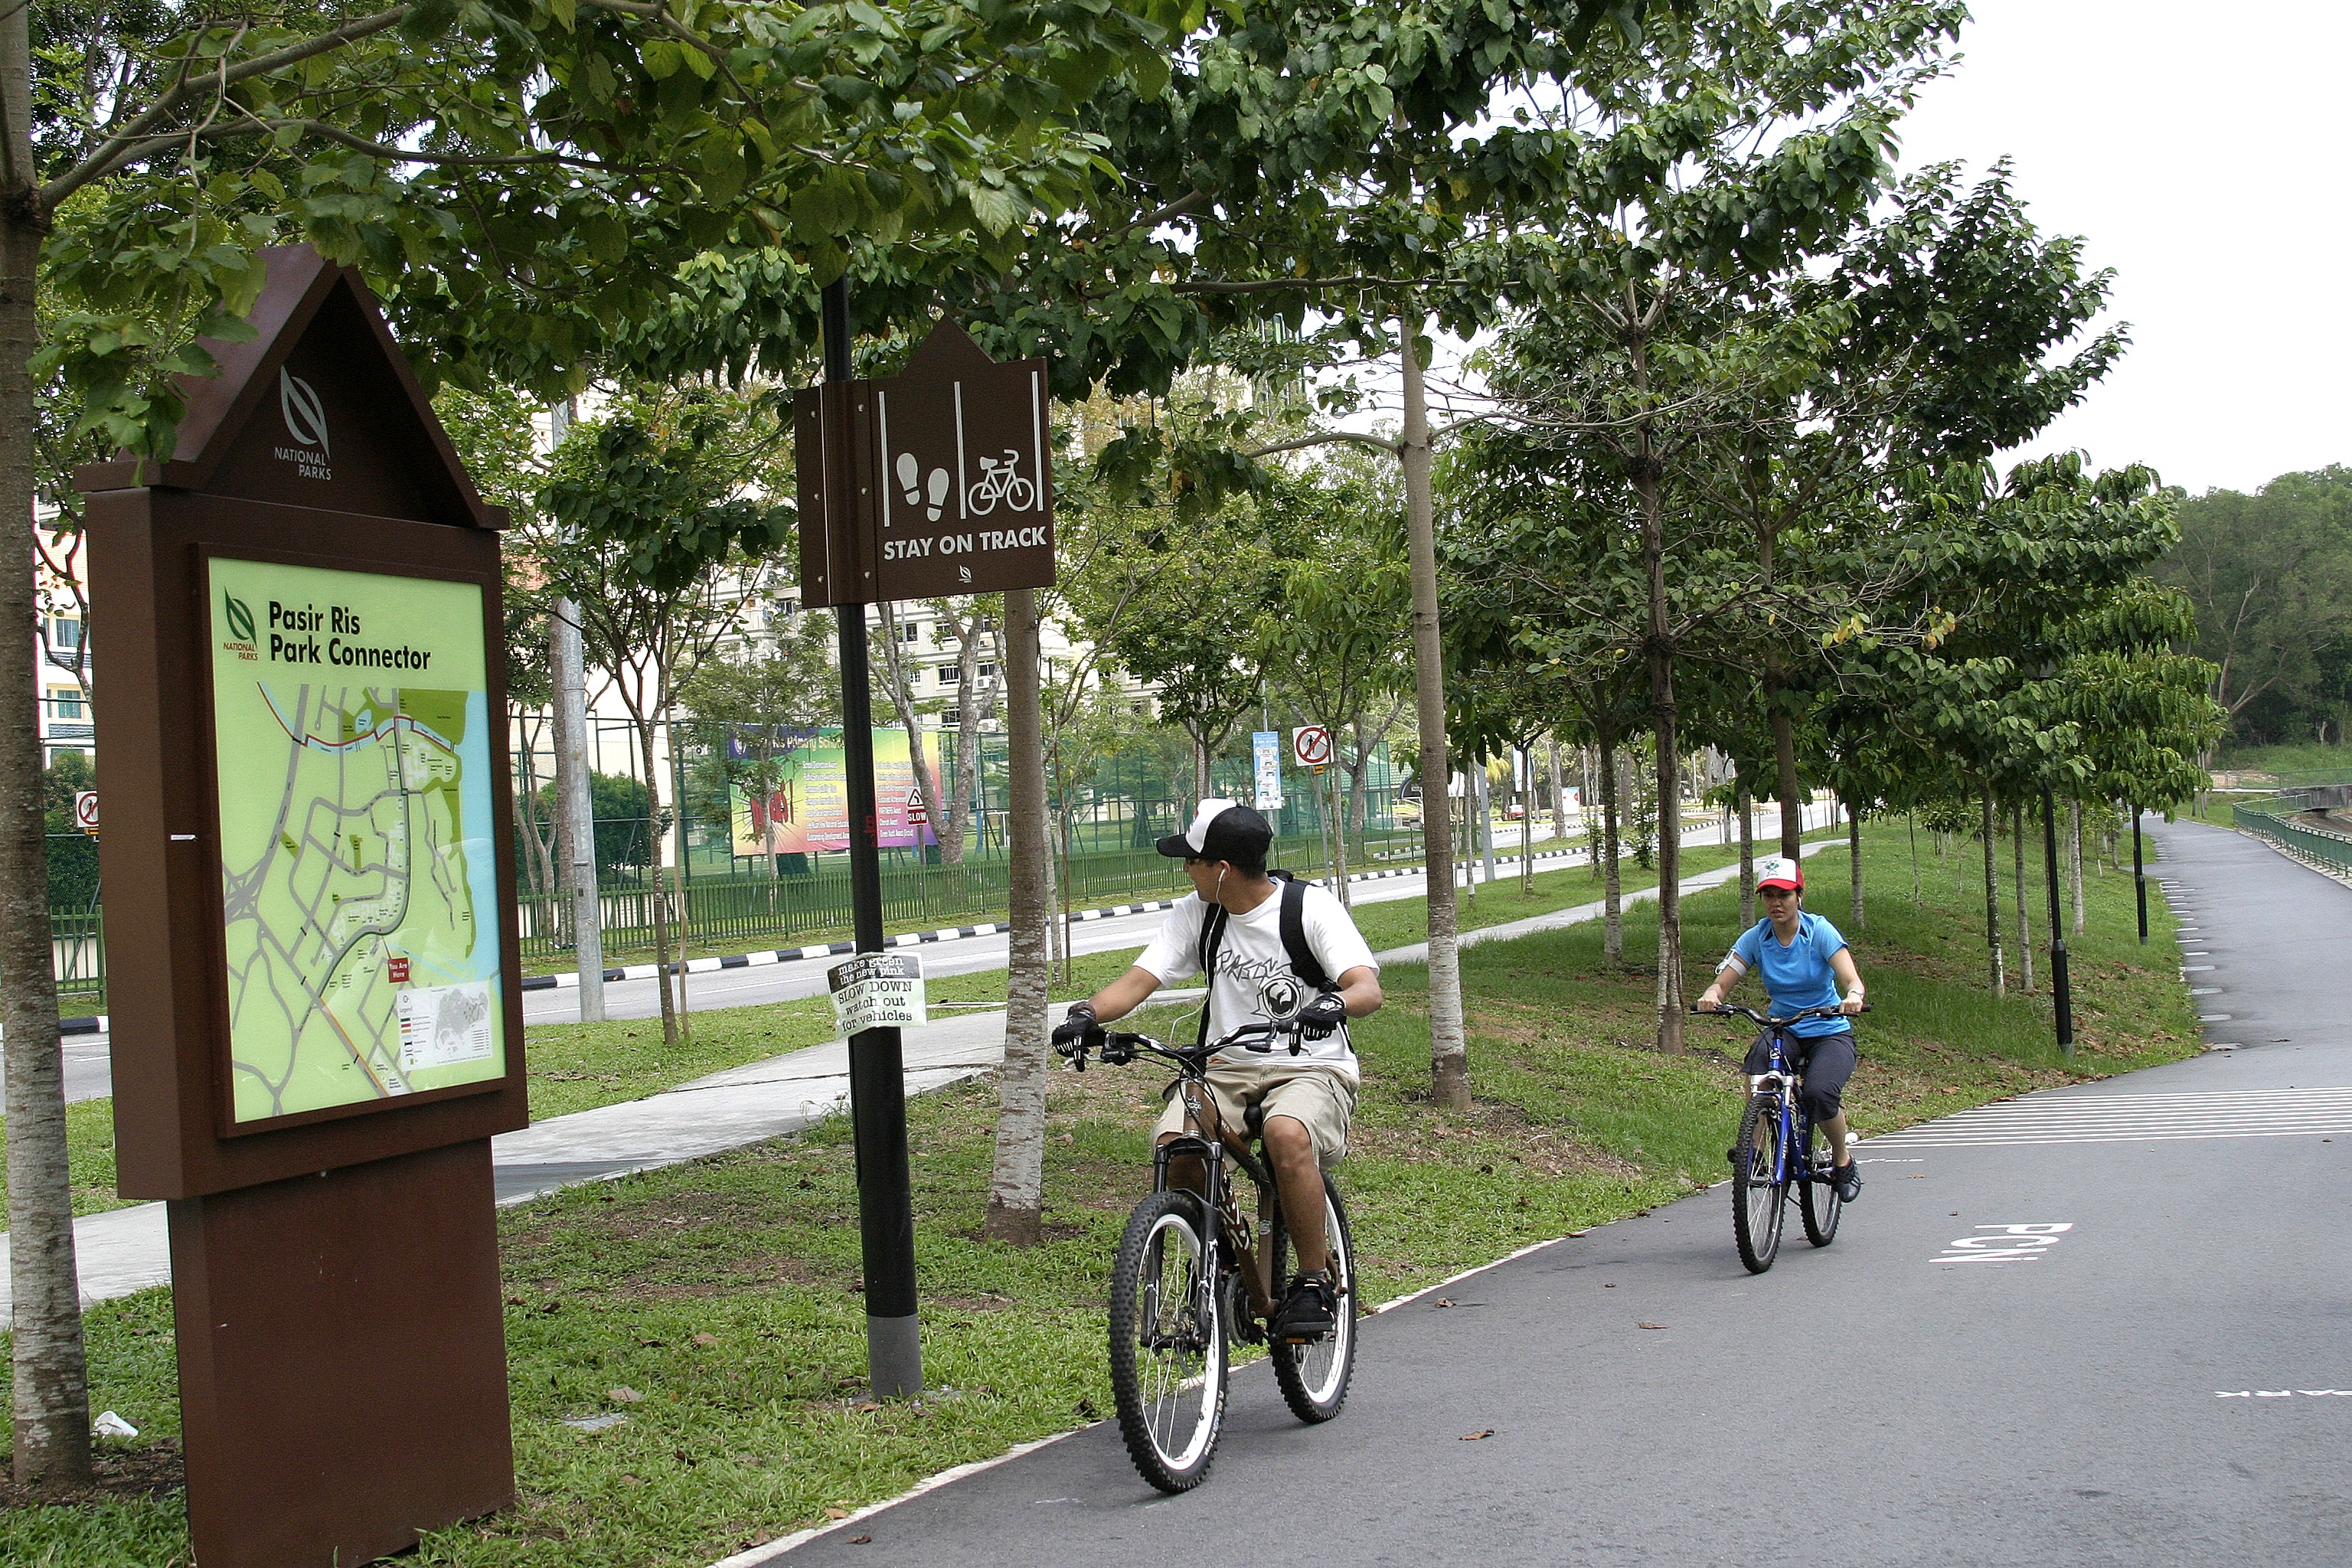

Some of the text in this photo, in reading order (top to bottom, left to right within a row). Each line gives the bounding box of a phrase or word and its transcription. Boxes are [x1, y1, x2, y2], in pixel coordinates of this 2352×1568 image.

[274, 447, 326, 466] NATIONAL
[299, 465, 332, 481] PARKS
[884, 526, 1047, 560] STAY ON TRACK
[269, 601, 361, 635] Pasir Ris
[223, 642, 256, 652] NATIONAL
[238, 652, 259, 661] PARKS
[270, 633, 431, 670] Park Connector
[907, 812, 927, 822] SLOW
[838, 957, 903, 975] make green
[840, 966, 905, 985] the new pink
[838, 981, 913, 1004] SLOW DOWN
[845, 996, 906, 1015] watch out
[842, 1010, 913, 1032] for vehicles
[1929, 1222, 2074, 1263] PCN
